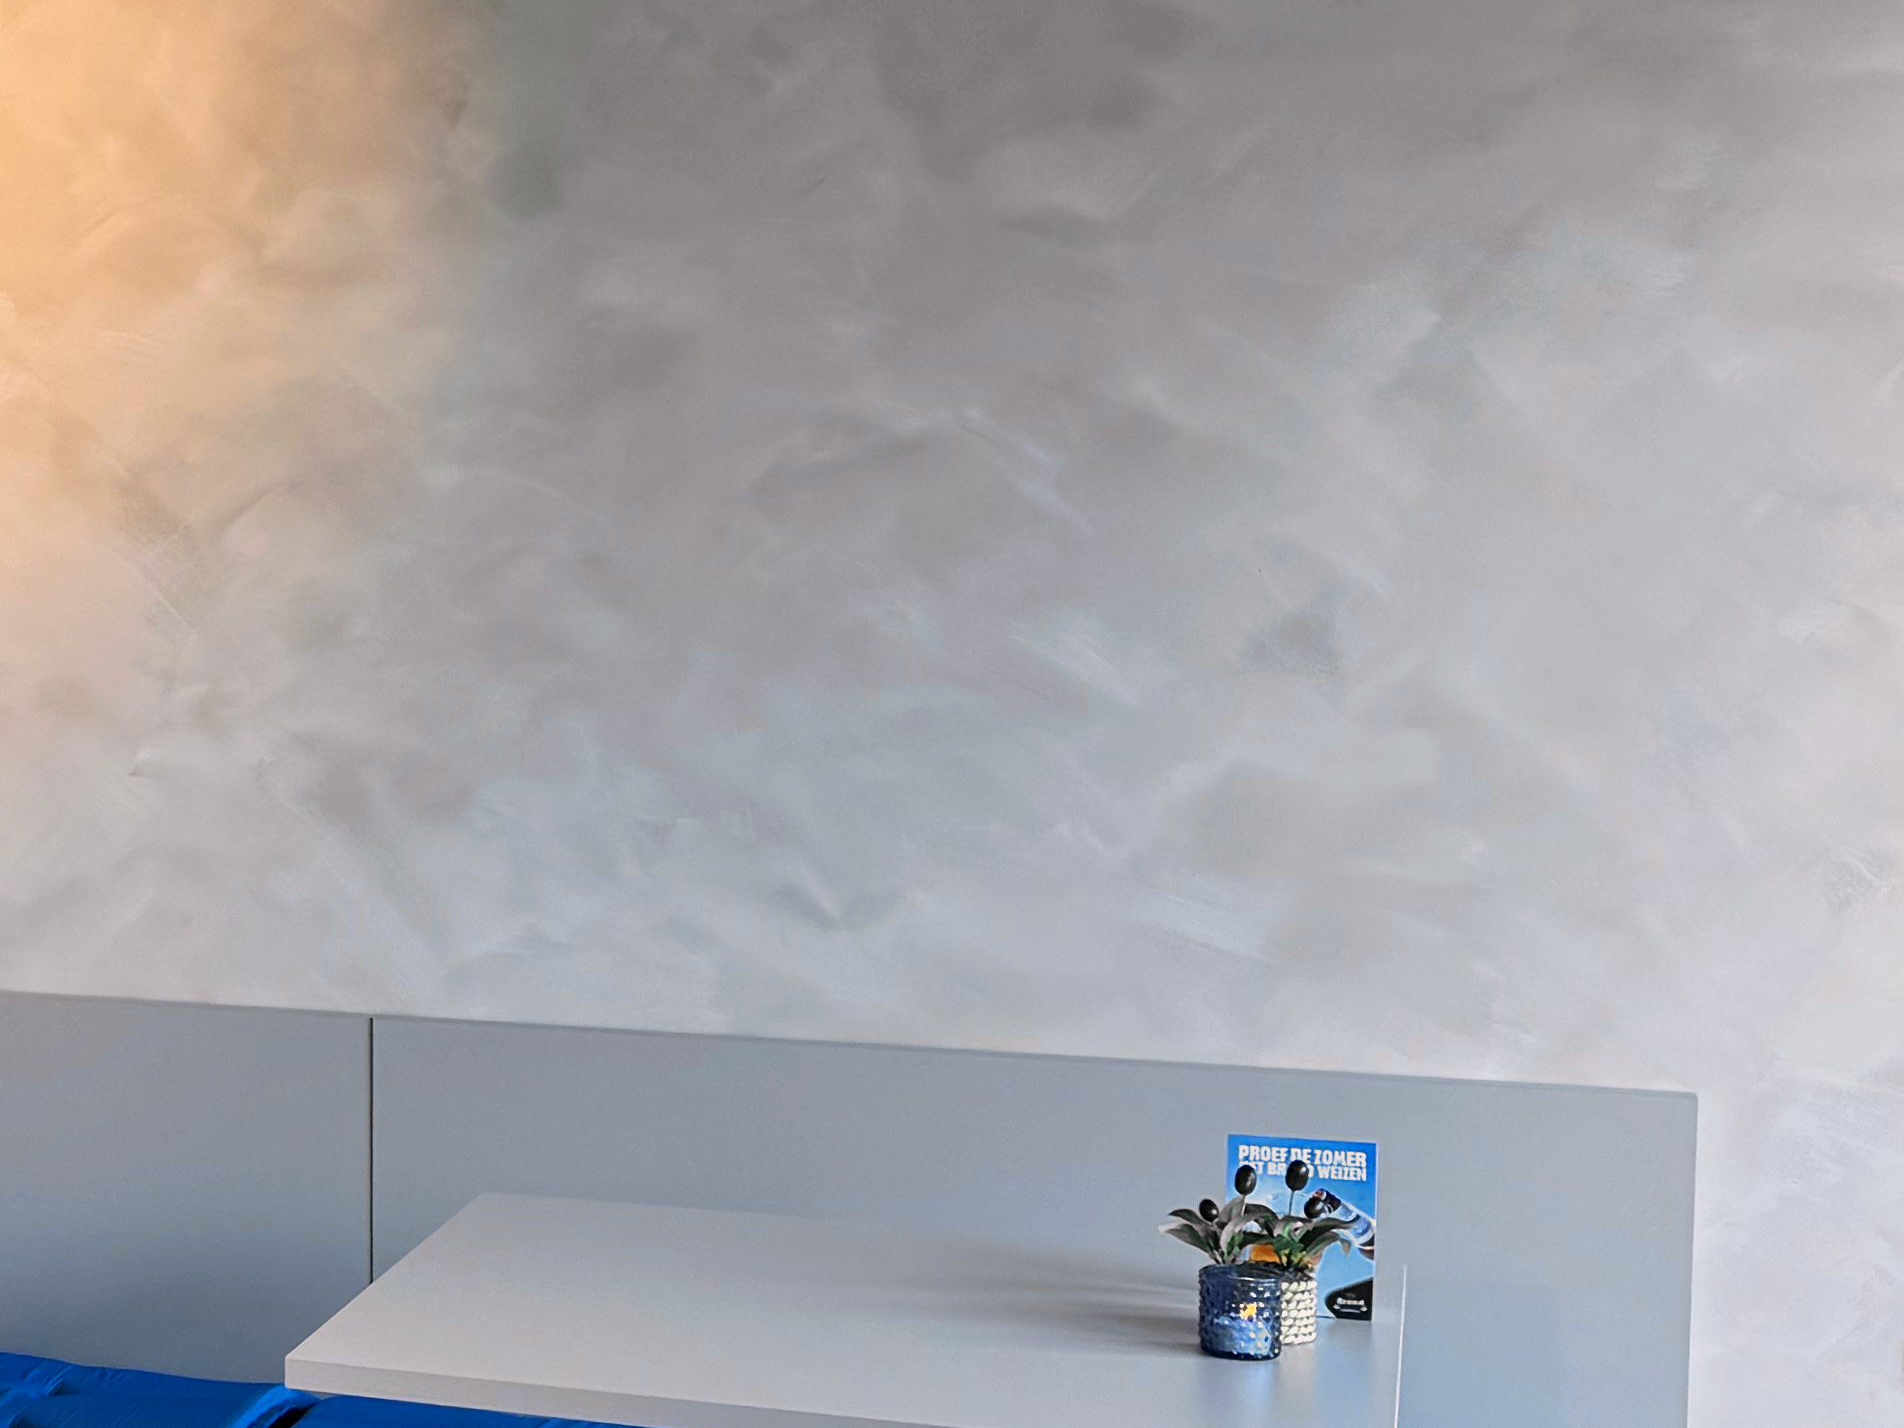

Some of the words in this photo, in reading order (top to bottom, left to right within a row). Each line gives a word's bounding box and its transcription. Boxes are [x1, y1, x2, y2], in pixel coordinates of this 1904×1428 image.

[1239, 1145, 1288, 1162] PROEF
[1290, 1148, 1311, 1163] DE
[1314, 1149, 1367, 1168] ZOMER
[1268, 1163, 1314, 1178] BRD
